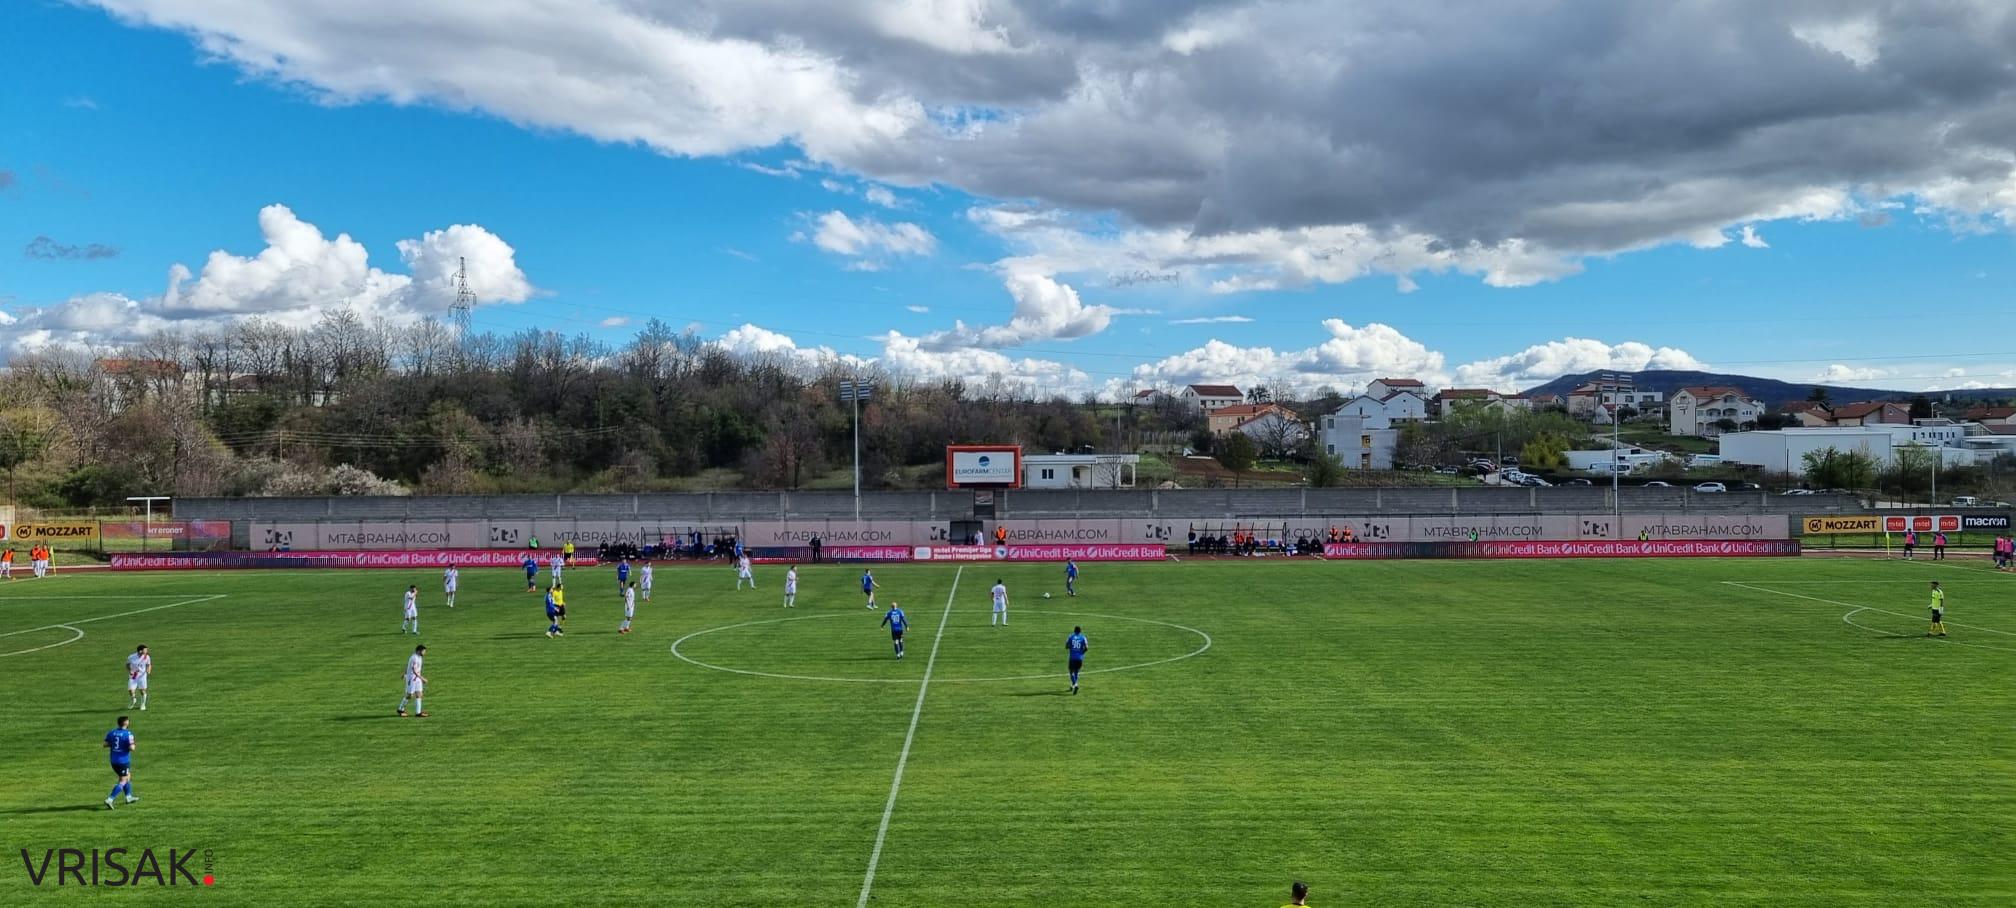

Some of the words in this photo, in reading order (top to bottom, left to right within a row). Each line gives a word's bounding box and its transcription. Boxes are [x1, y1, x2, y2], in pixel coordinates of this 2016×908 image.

[1825, 520, 1877, 530] MOZZART
[1965, 517, 2007, 526] macron
[35, 526, 92, 537] MOZZART
[1643, 525, 1763, 536] MTABRAHAM.COM
[328, 533, 450, 544] MTABRAHAM.COM
[1020, 547, 1061, 558] UniCredit
[1062, 548, 1086, 558] Bank
[1100, 547, 1136, 558] UniCredit
[1140, 547, 1165, 558] Bank
[1537, 544, 1561, 555] Bank
[1573, 543, 1614, 554] UniCredit
[1616, 543, 1640, 554] Bank
[1652, 542, 1694, 554] UniCredit
[1696, 542, 1720, 554] Bank
[367, 553, 409, 564] UniCredit
[411, 553, 436, 563] Bank
[449, 552, 491, 563] UniCredit
[492, 552, 517, 563] Bank
[114, 736, 120, 750] 3
